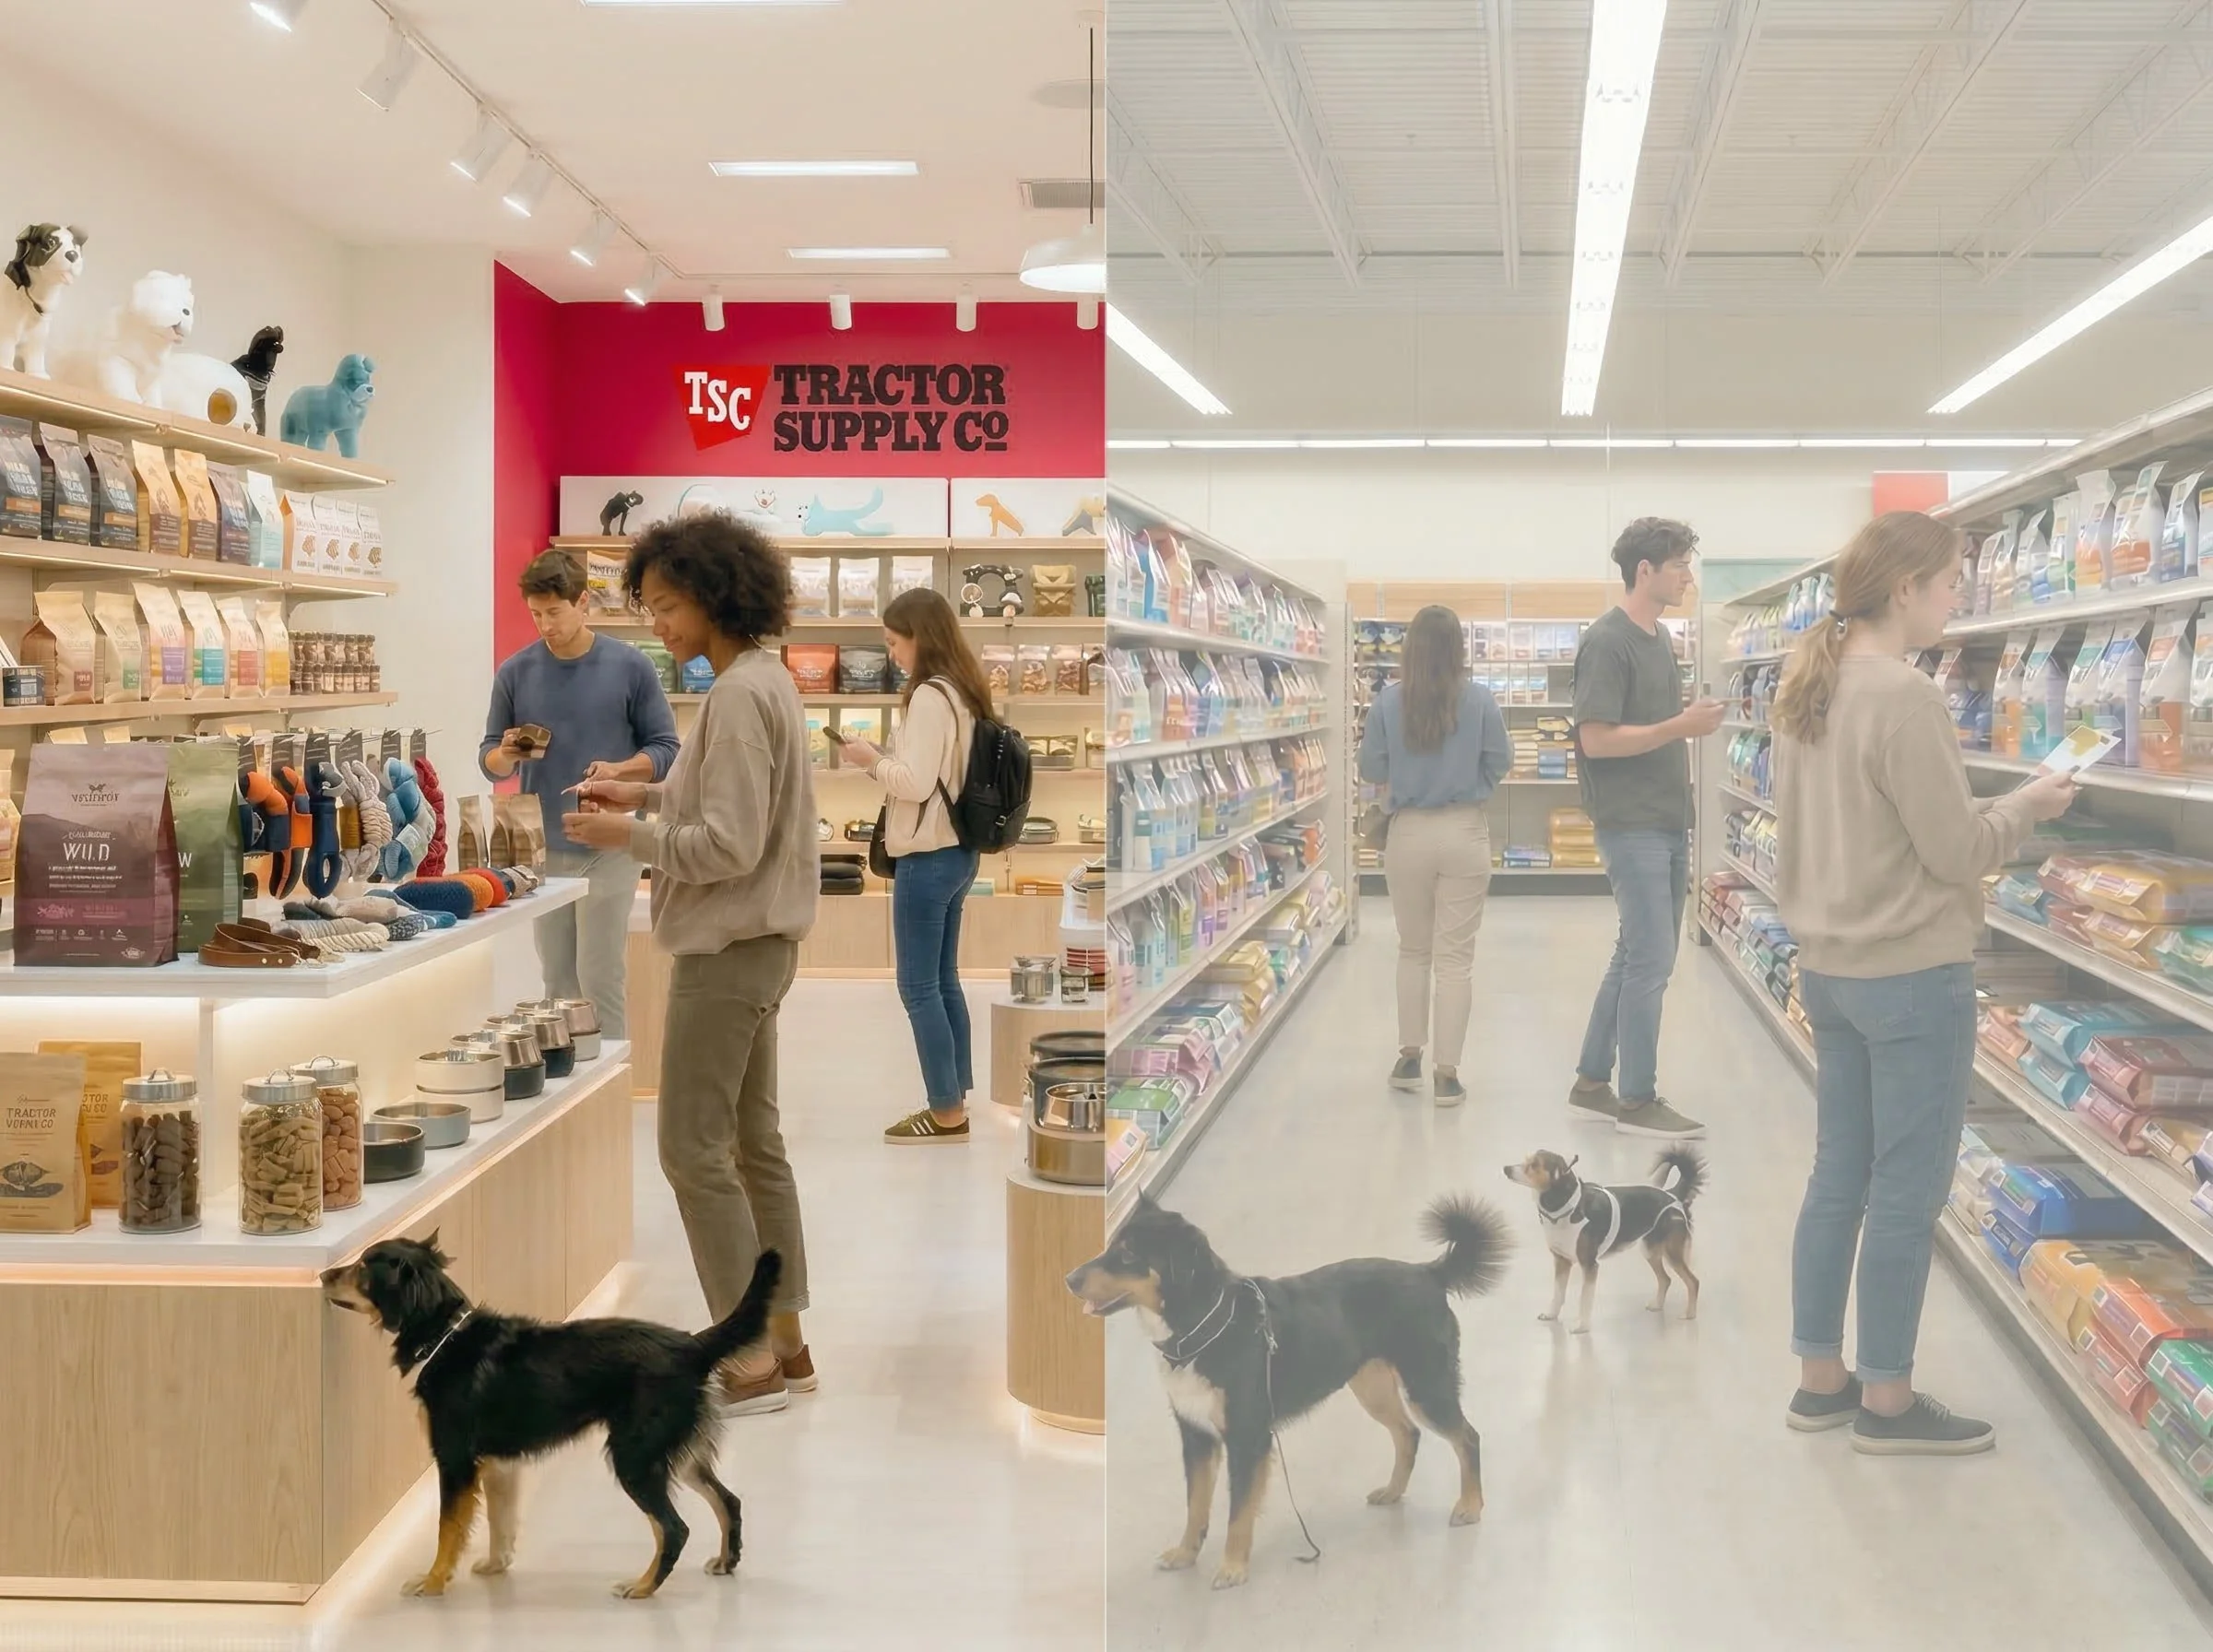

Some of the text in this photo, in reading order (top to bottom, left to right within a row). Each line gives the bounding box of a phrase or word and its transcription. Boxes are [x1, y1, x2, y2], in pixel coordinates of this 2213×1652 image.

[684, 372, 751, 431] TSC
[774, 364, 1006, 406] TRACTOR
[774, 411, 948, 452] SUPPLY
